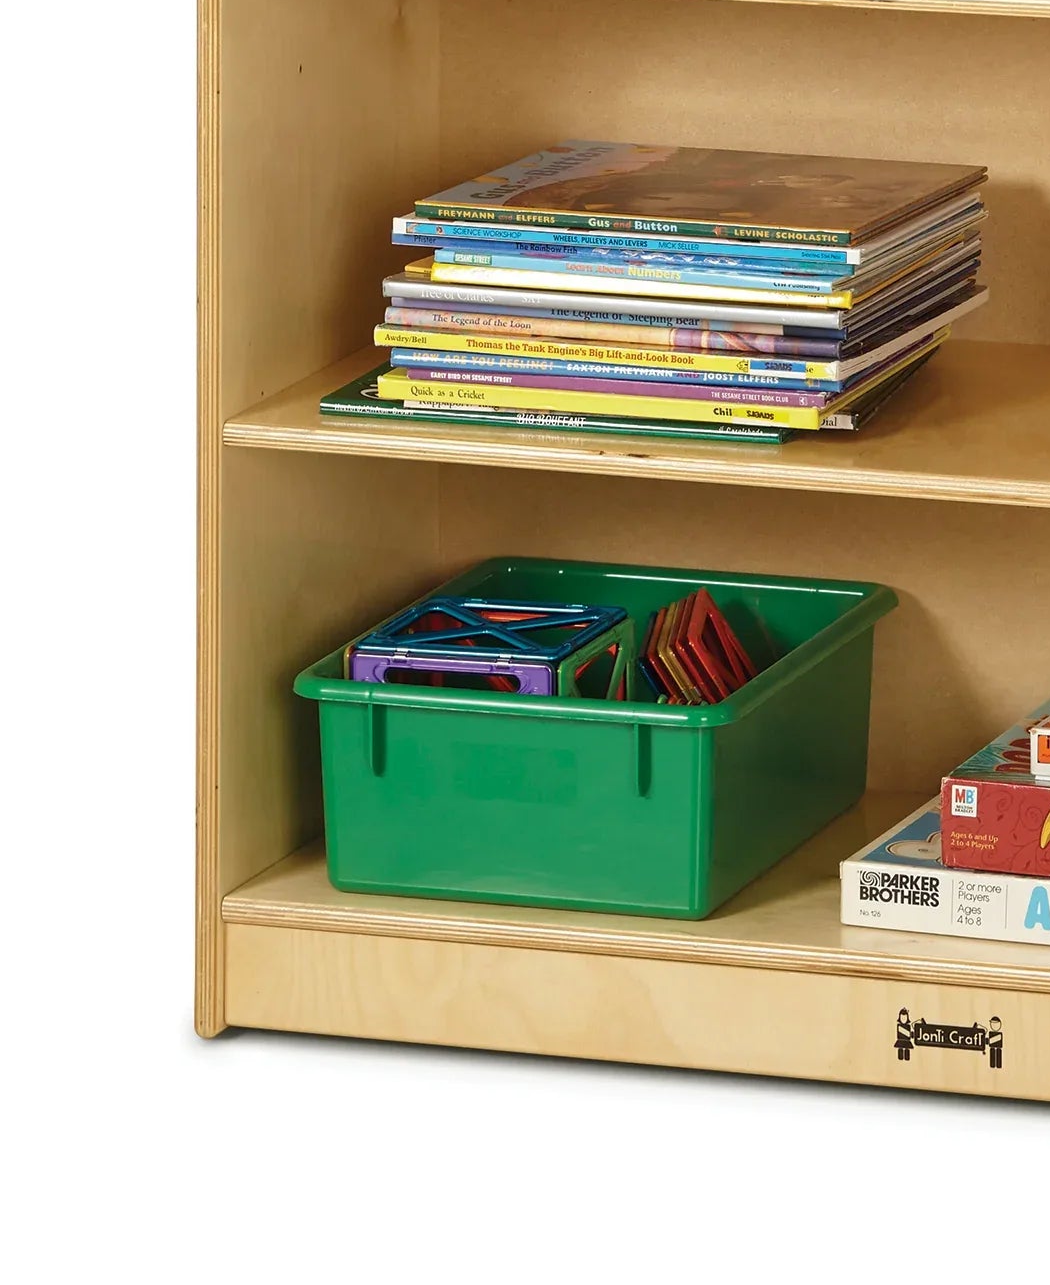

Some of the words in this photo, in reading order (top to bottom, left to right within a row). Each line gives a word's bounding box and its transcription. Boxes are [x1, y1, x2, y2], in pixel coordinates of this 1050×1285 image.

[438, 209, 495, 220] FREYMANN
[588, 218, 610, 228] Gus
[613, 220, 631, 229] and
[634, 221, 678, 232] Button
[453, 228, 482, 237] SCIENCE
[734, 228, 770, 238] LEVINE
[775, 231, 838, 243] SCHOLASTIC
[581, 236, 608, 245] PULLEYS
[608, 238, 624, 246] AND
[624, 239, 648, 248] LEVERS
[658, 241, 677, 250] MICK
[677, 242, 699, 251] SELLER
[515, 243, 529, 251] The
[530, 244, 562, 253] Rainbow
[563, 246, 578, 254] Fish
[473, 255, 491, 264] STREET
[627, 267, 681, 280] Numbers
[432, 314, 448, 323] The
[450, 316, 481, 326] Legend
[482, 317, 492, 326] of
[493, 319, 508, 328] the
[510, 320, 531, 329] Loon
[384, 333, 427, 344] Awdry/Bell
[466, 339, 503, 350] Thomas
[505, 341, 521, 351] the
[522, 344, 546, 353] Tank
[547, 346, 587, 357] Engine's
[589, 349, 604, 359] Big
[606, 350, 668, 363] Lift-and-Look
[671, 354, 695, 365] Book
[430, 371, 447, 379] EARLY
[448, 372, 461, 380] BIRD
[471, 374, 493, 382] SESAME
[493, 375, 512, 384] STREET
[702, 373, 735, 382] JOOST
[737, 374, 780, 384] ELFFERS
[411, 386, 433, 397] Quick
[457, 389, 485, 400] Cricket
[711, 391, 721, 399] THE
[721, 392, 742, 400] SESAME
[742, 393, 760, 401] STREET
[775, 395, 789, 403] CLUB
[955, 788, 974, 804] MB
[950, 831, 967, 840] Ages
[988, 834, 999, 843] Up
[971, 842, 995, 851] Players
[881, 872, 940, 893] PARKER
[958, 881, 965, 890] 2
[966, 883, 977, 892] or
[977, 885, 1002, 894] more
[859, 886, 940, 908] BROTHERS
[958, 891, 990, 903] Players
[957, 904, 982, 916] Ages
[957, 915, 964, 924] 4
[965, 916, 974, 925] to
[976, 916, 982, 926] 8
